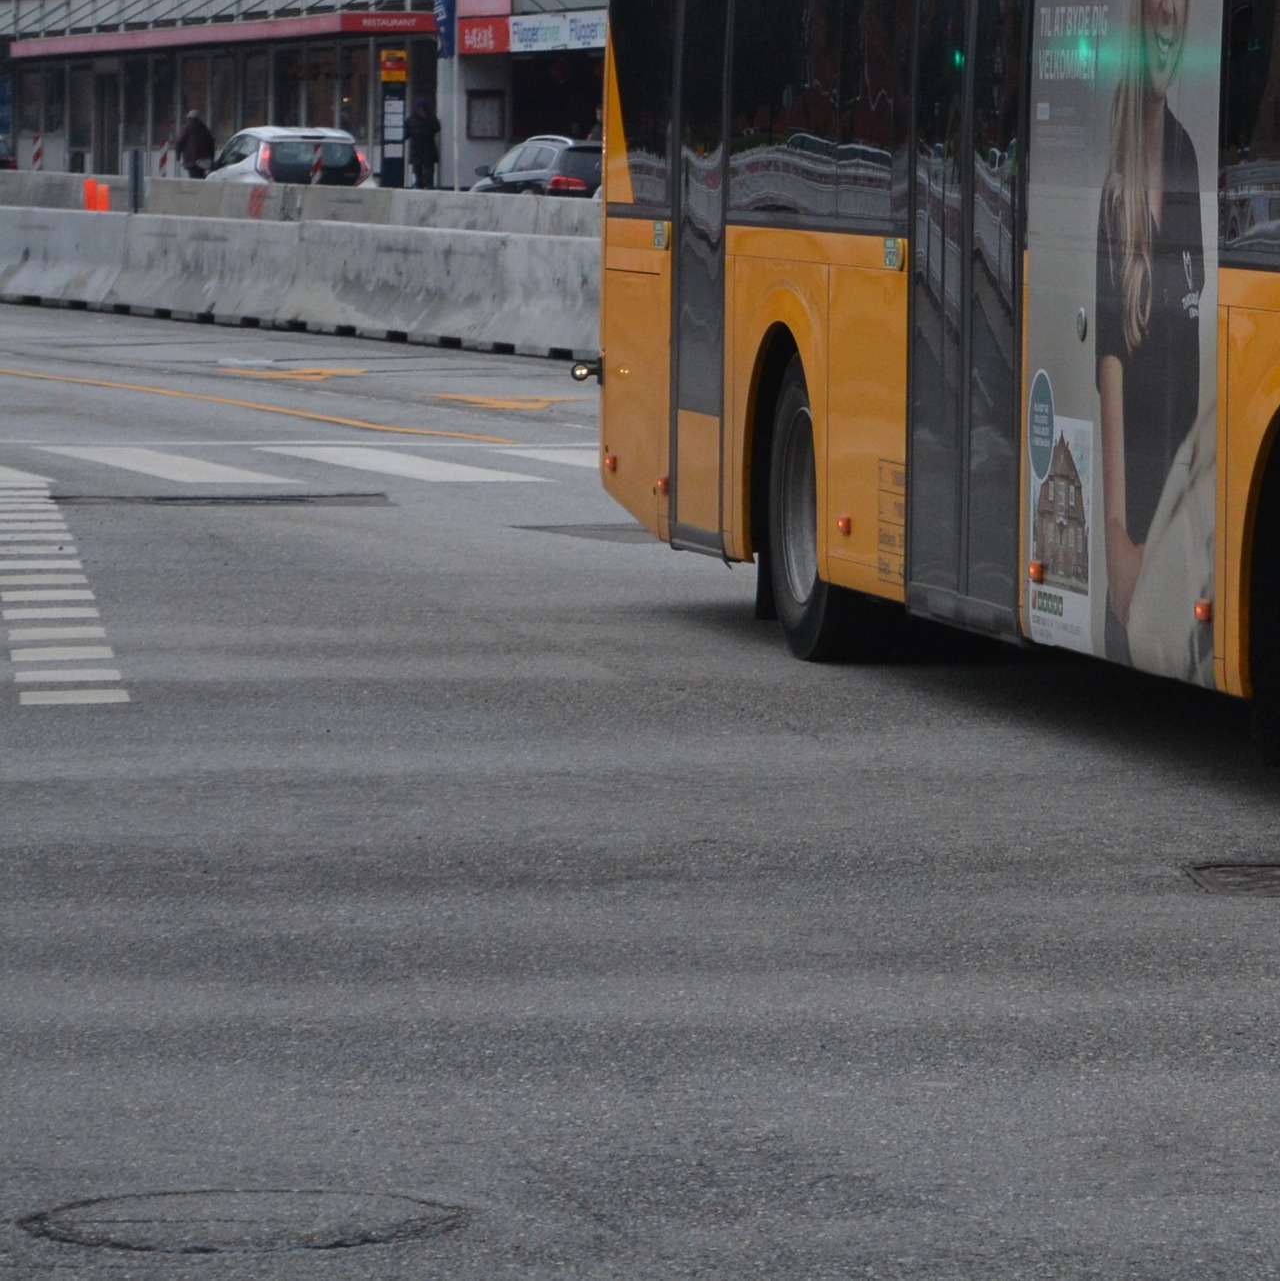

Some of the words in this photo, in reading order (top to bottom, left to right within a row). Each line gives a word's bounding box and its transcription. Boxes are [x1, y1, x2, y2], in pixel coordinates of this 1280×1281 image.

[362, 18, 417, 27] RESTAURANT
[1040, 7, 1052, 37] TIL
[1053, 6, 1066, 36] AT
[1066, 6, 1090, 36] BYDE
[1092, 5, 1109, 36] DIG
[1038, 48, 1096, 80] VELKOMMEN
